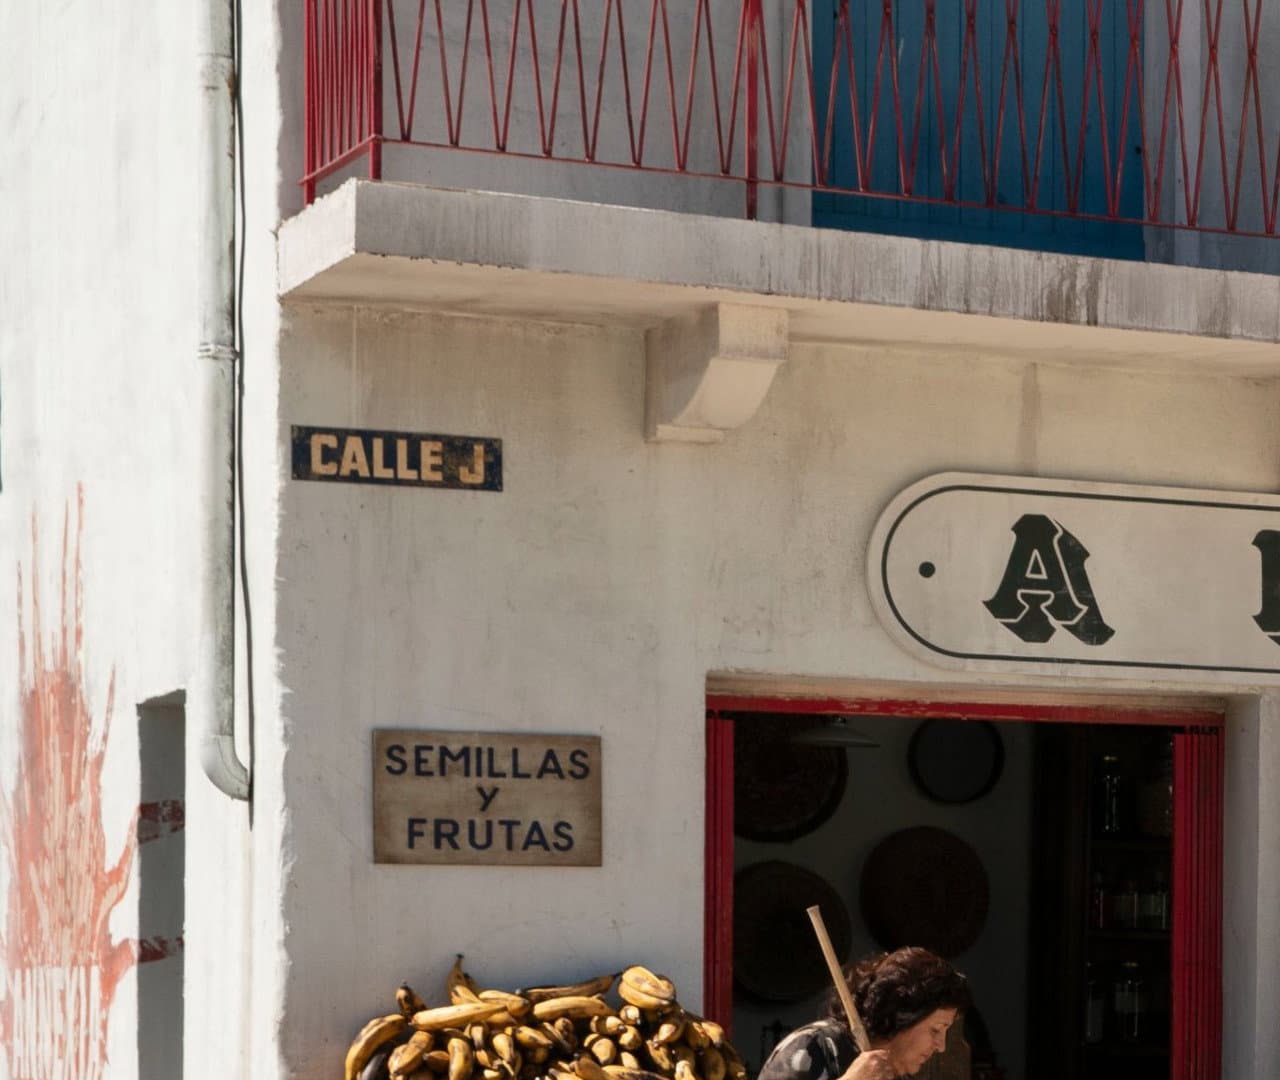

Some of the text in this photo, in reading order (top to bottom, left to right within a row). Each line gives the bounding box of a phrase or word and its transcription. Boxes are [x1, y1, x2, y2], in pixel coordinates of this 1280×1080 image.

[310, 433, 486, 484] CALLE J
[982, 514, 1116, 646] A
[384, 743, 591, 780] SEMILLAS
[406, 817, 575, 852] FRUTAS
